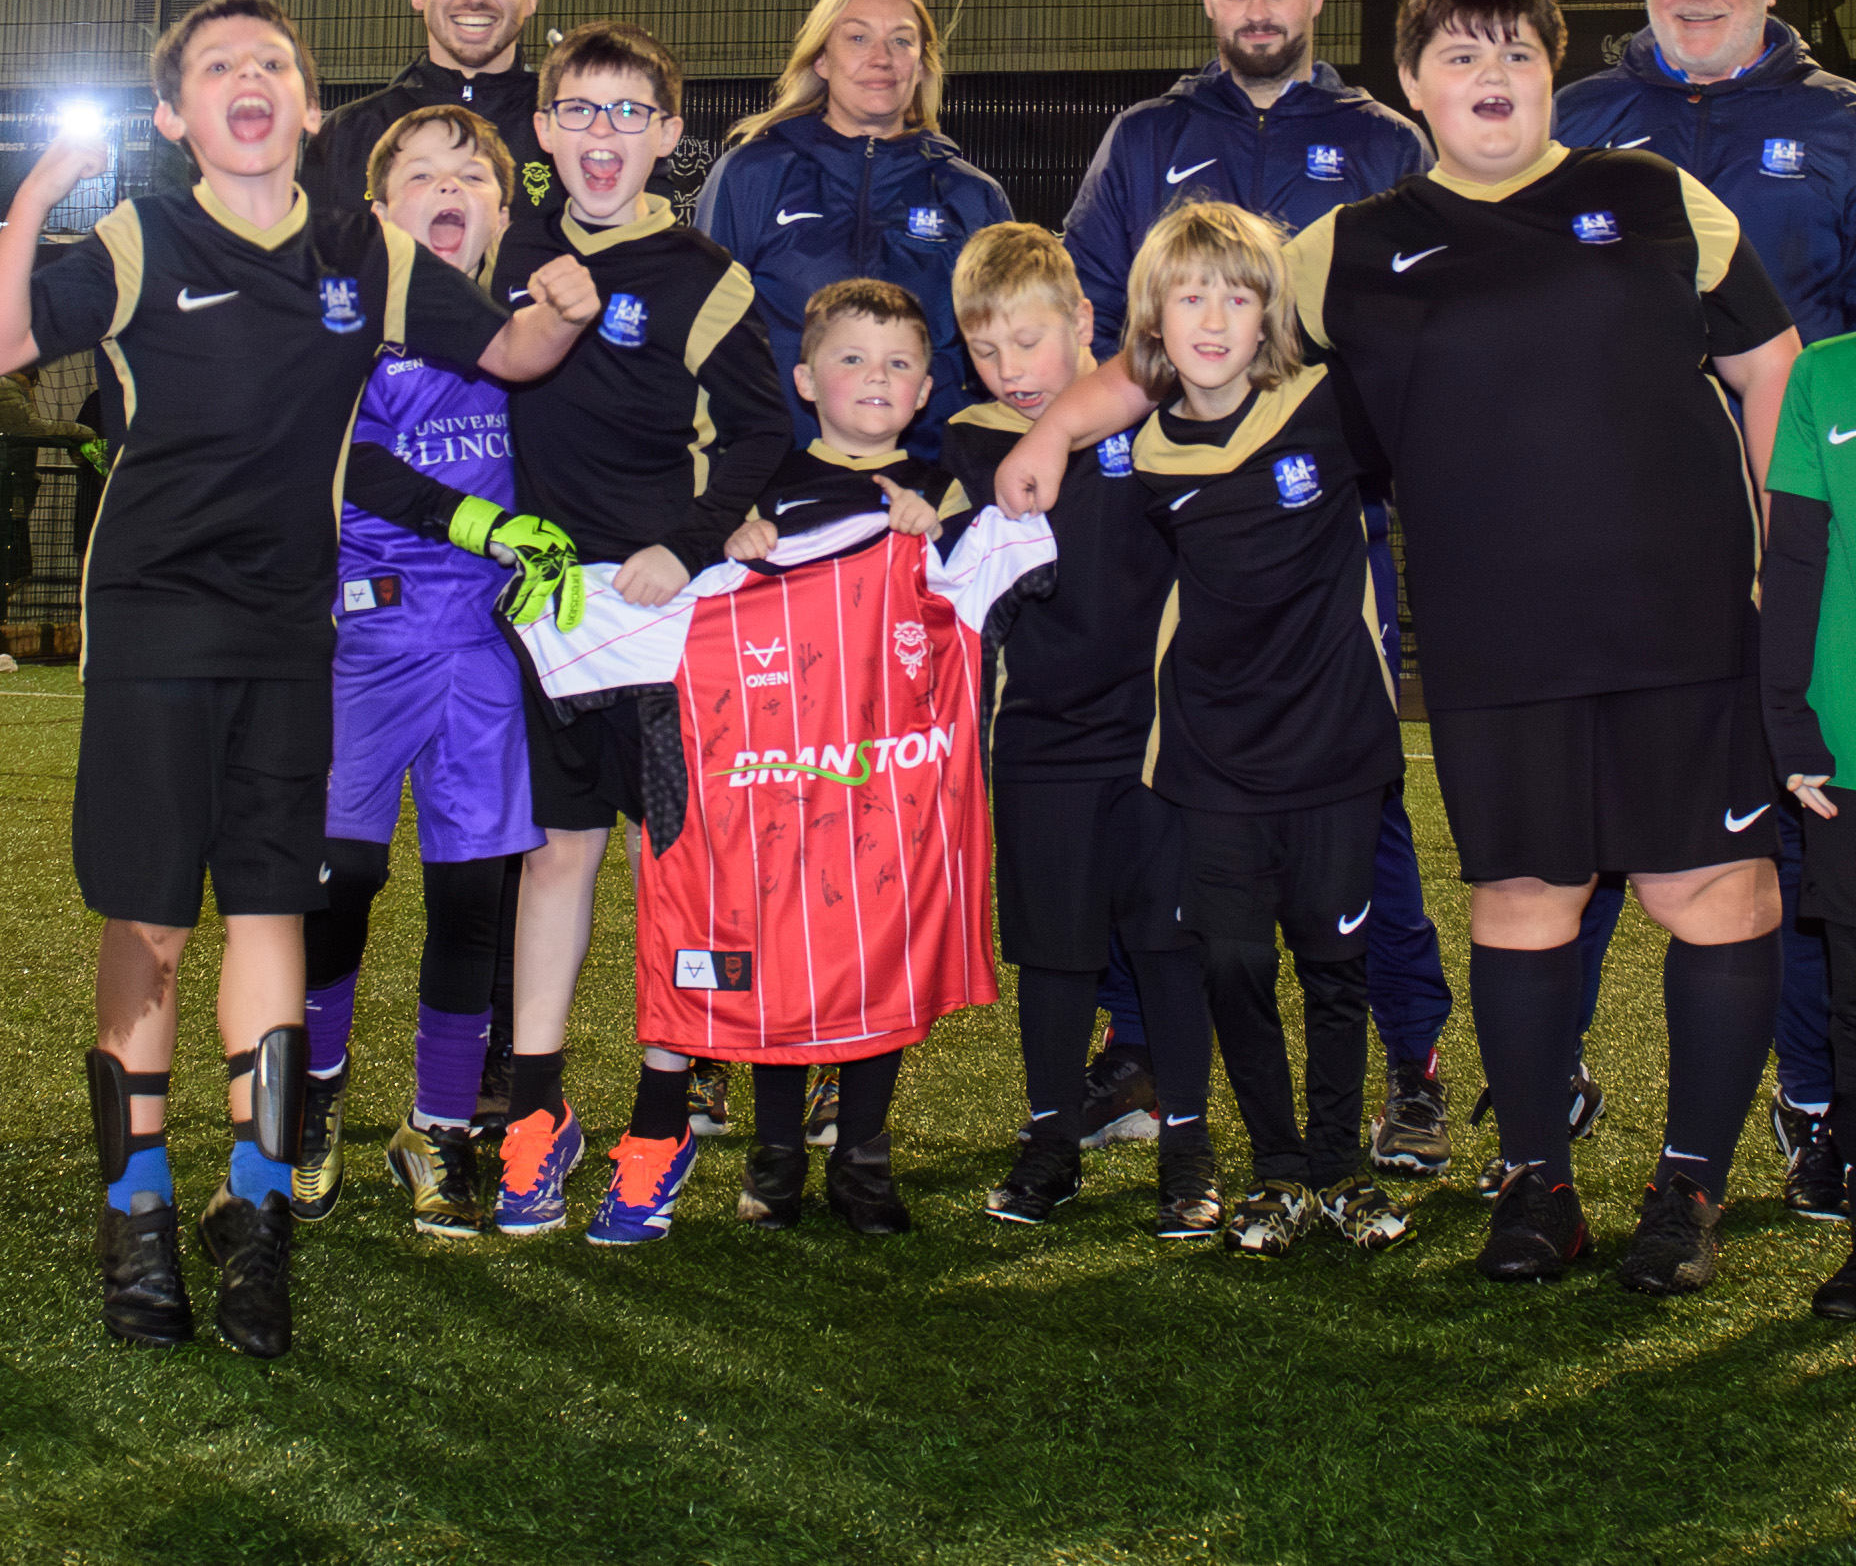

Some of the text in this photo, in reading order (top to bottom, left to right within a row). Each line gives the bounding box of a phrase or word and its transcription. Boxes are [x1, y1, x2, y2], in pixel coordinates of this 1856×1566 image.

[386, 357, 425, 376] OXEN
[745, 670, 789, 688] OXEN
[729, 722, 956, 788] BRANSTON
